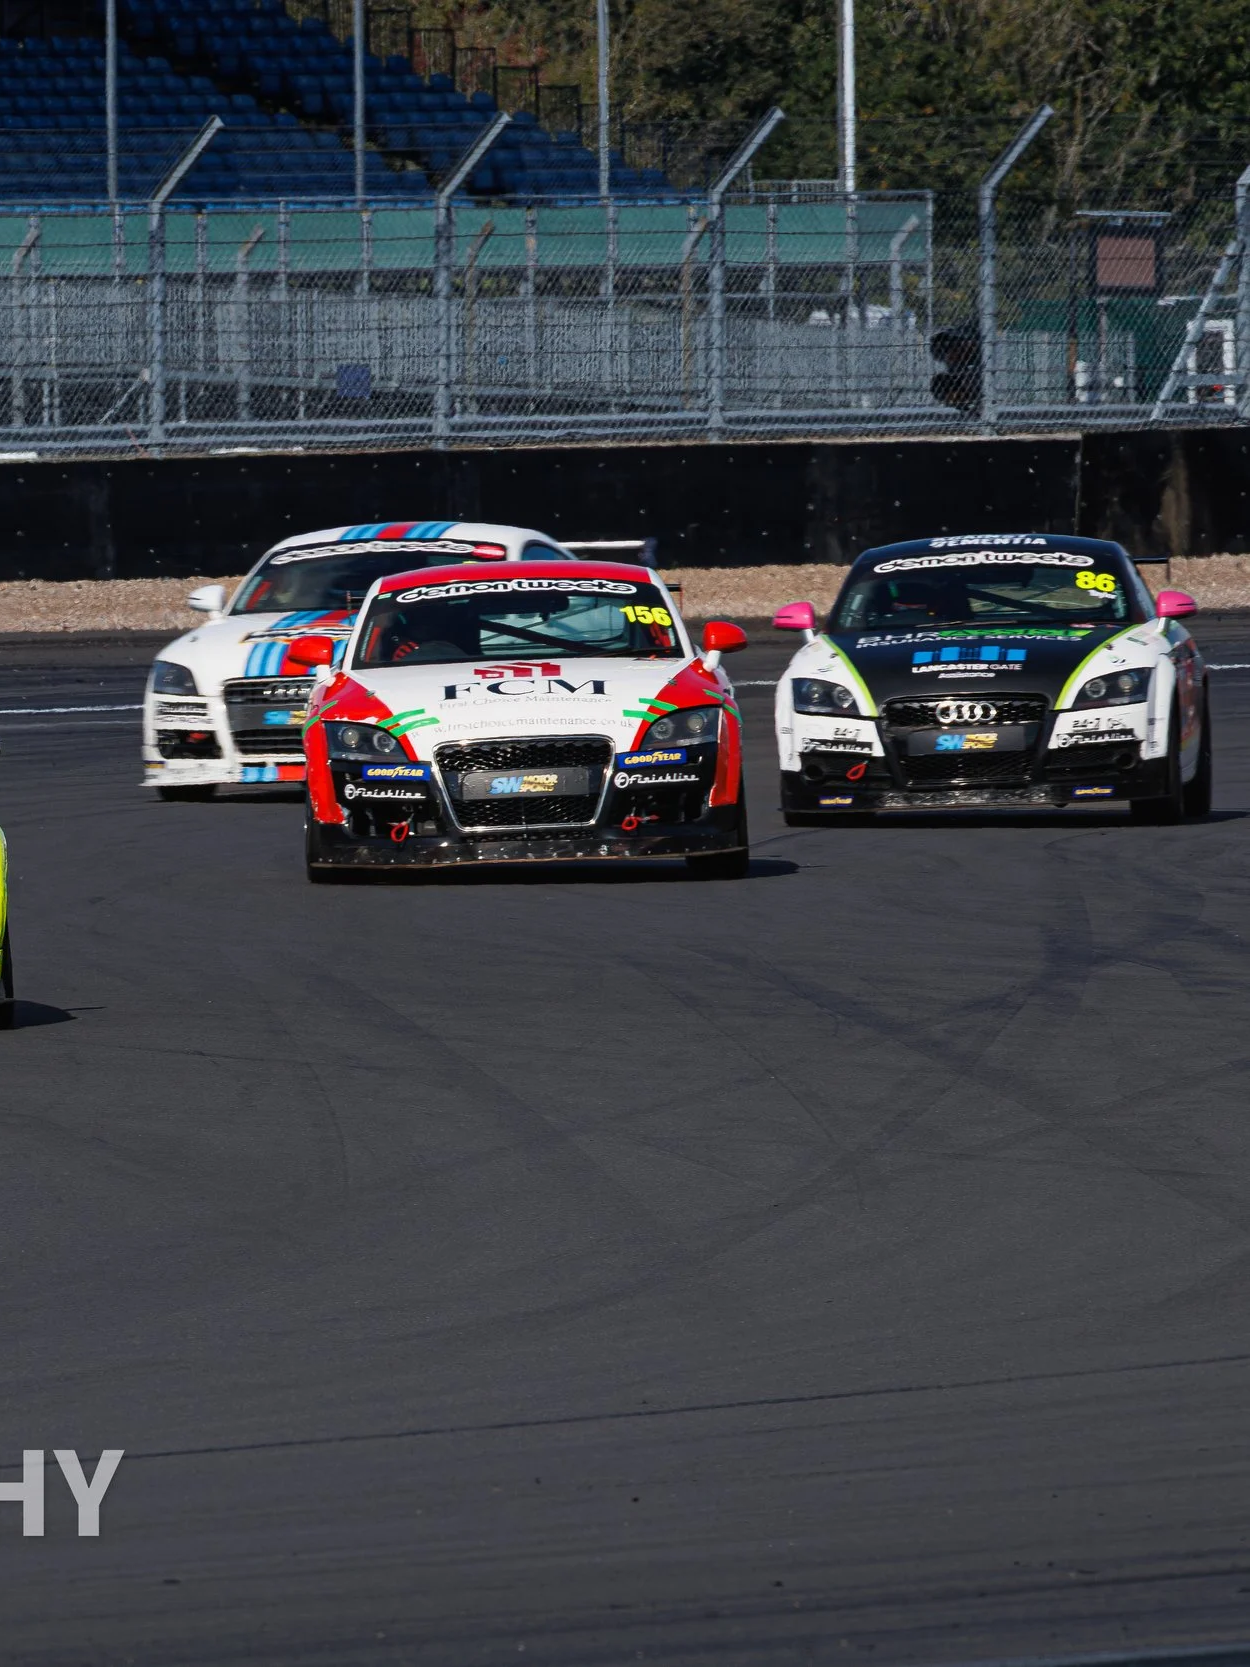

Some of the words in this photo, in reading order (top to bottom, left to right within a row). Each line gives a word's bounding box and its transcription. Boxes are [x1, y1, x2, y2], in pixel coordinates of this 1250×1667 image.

[1075, 571, 1116, 592] 86
[620, 606, 672, 626] 156
[856, 636, 979, 648] INSURANCE
[912, 664, 989, 674] LANCASTER
[990, 663, 1023, 671] GATE
[440, 679, 614, 700] FCM
[439, 701, 468, 710] First
[472, 696, 521, 706] Choice
[526, 695, 612, 703] Maintenance
[625, 752, 682, 764] GOODYEAR
[367, 766, 424, 778] GOODYEAR
[490, 777, 523, 794] SW
